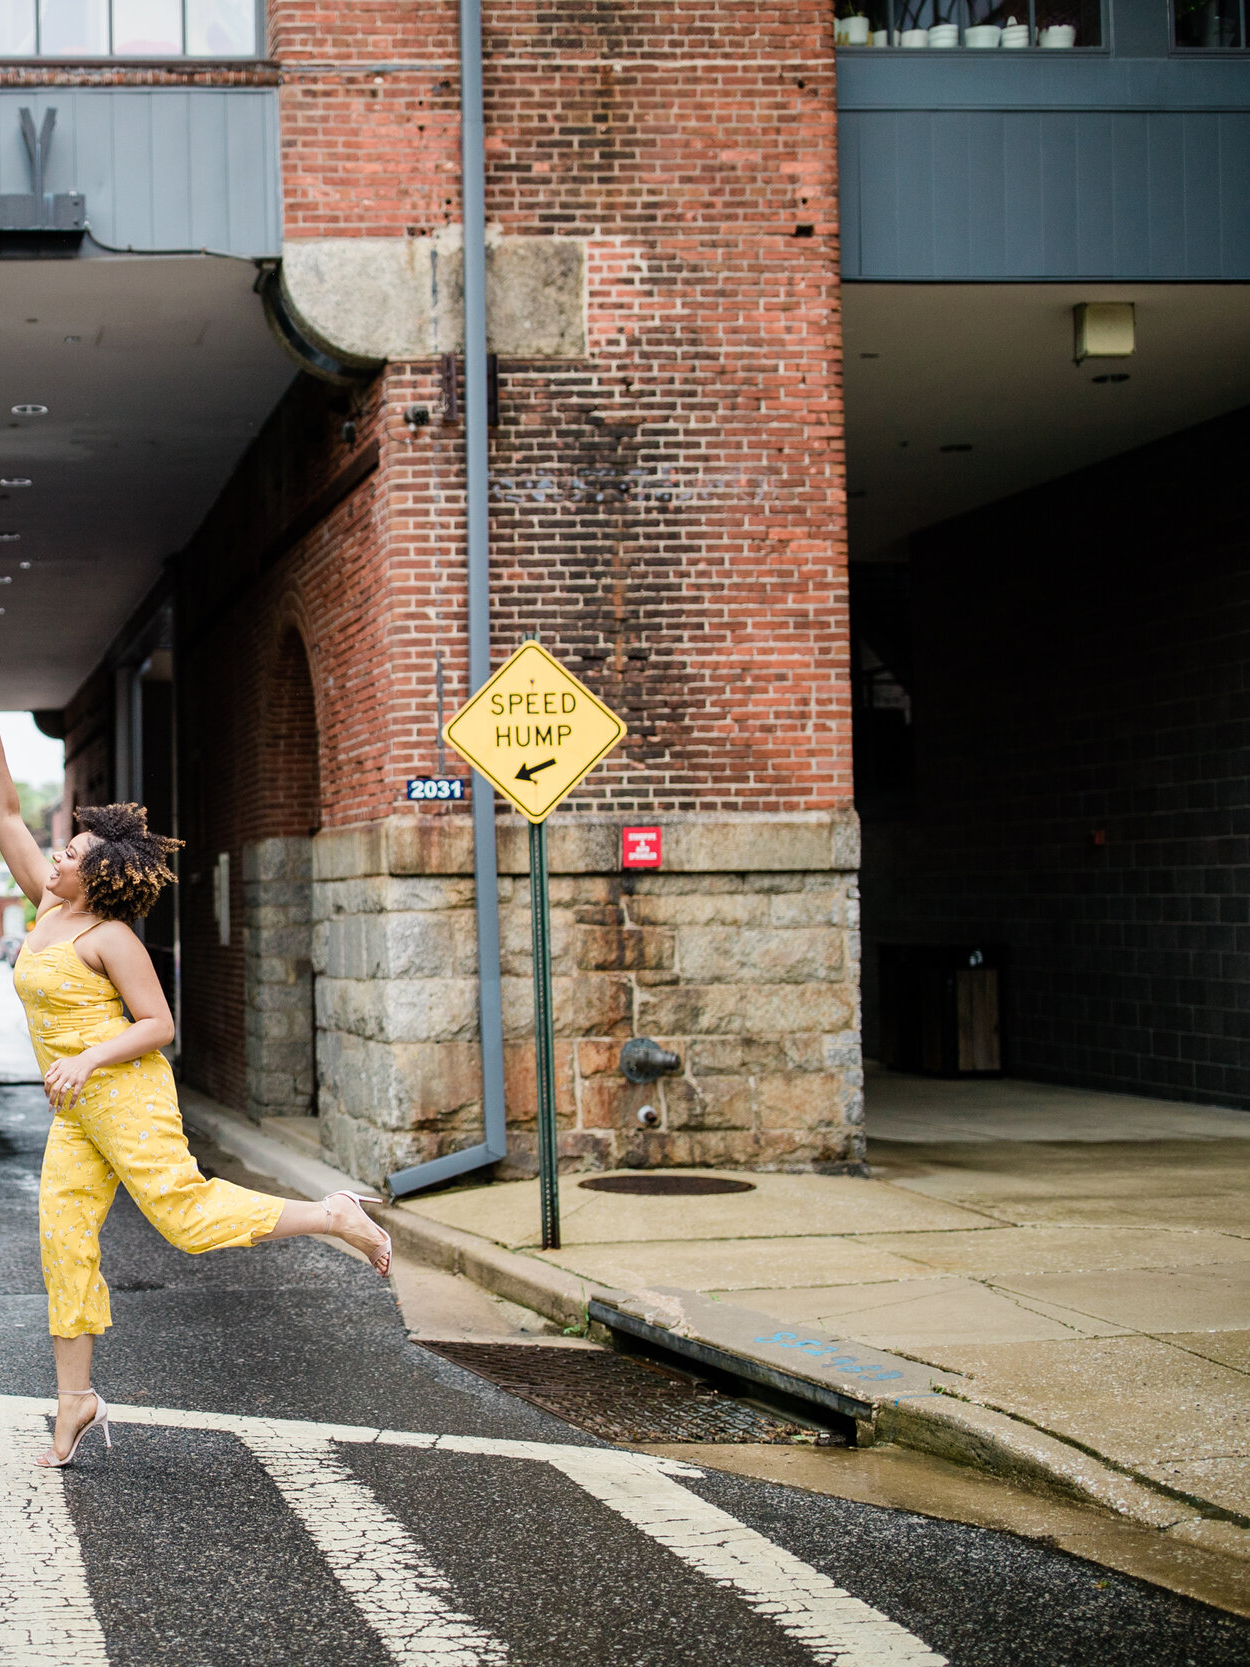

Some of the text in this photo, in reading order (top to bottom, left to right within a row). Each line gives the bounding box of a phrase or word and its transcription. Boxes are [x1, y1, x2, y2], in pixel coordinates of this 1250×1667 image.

[491, 692, 576, 715] SPEED
[496, 724, 572, 747] HUMP
[410, 780, 461, 799] 2031
